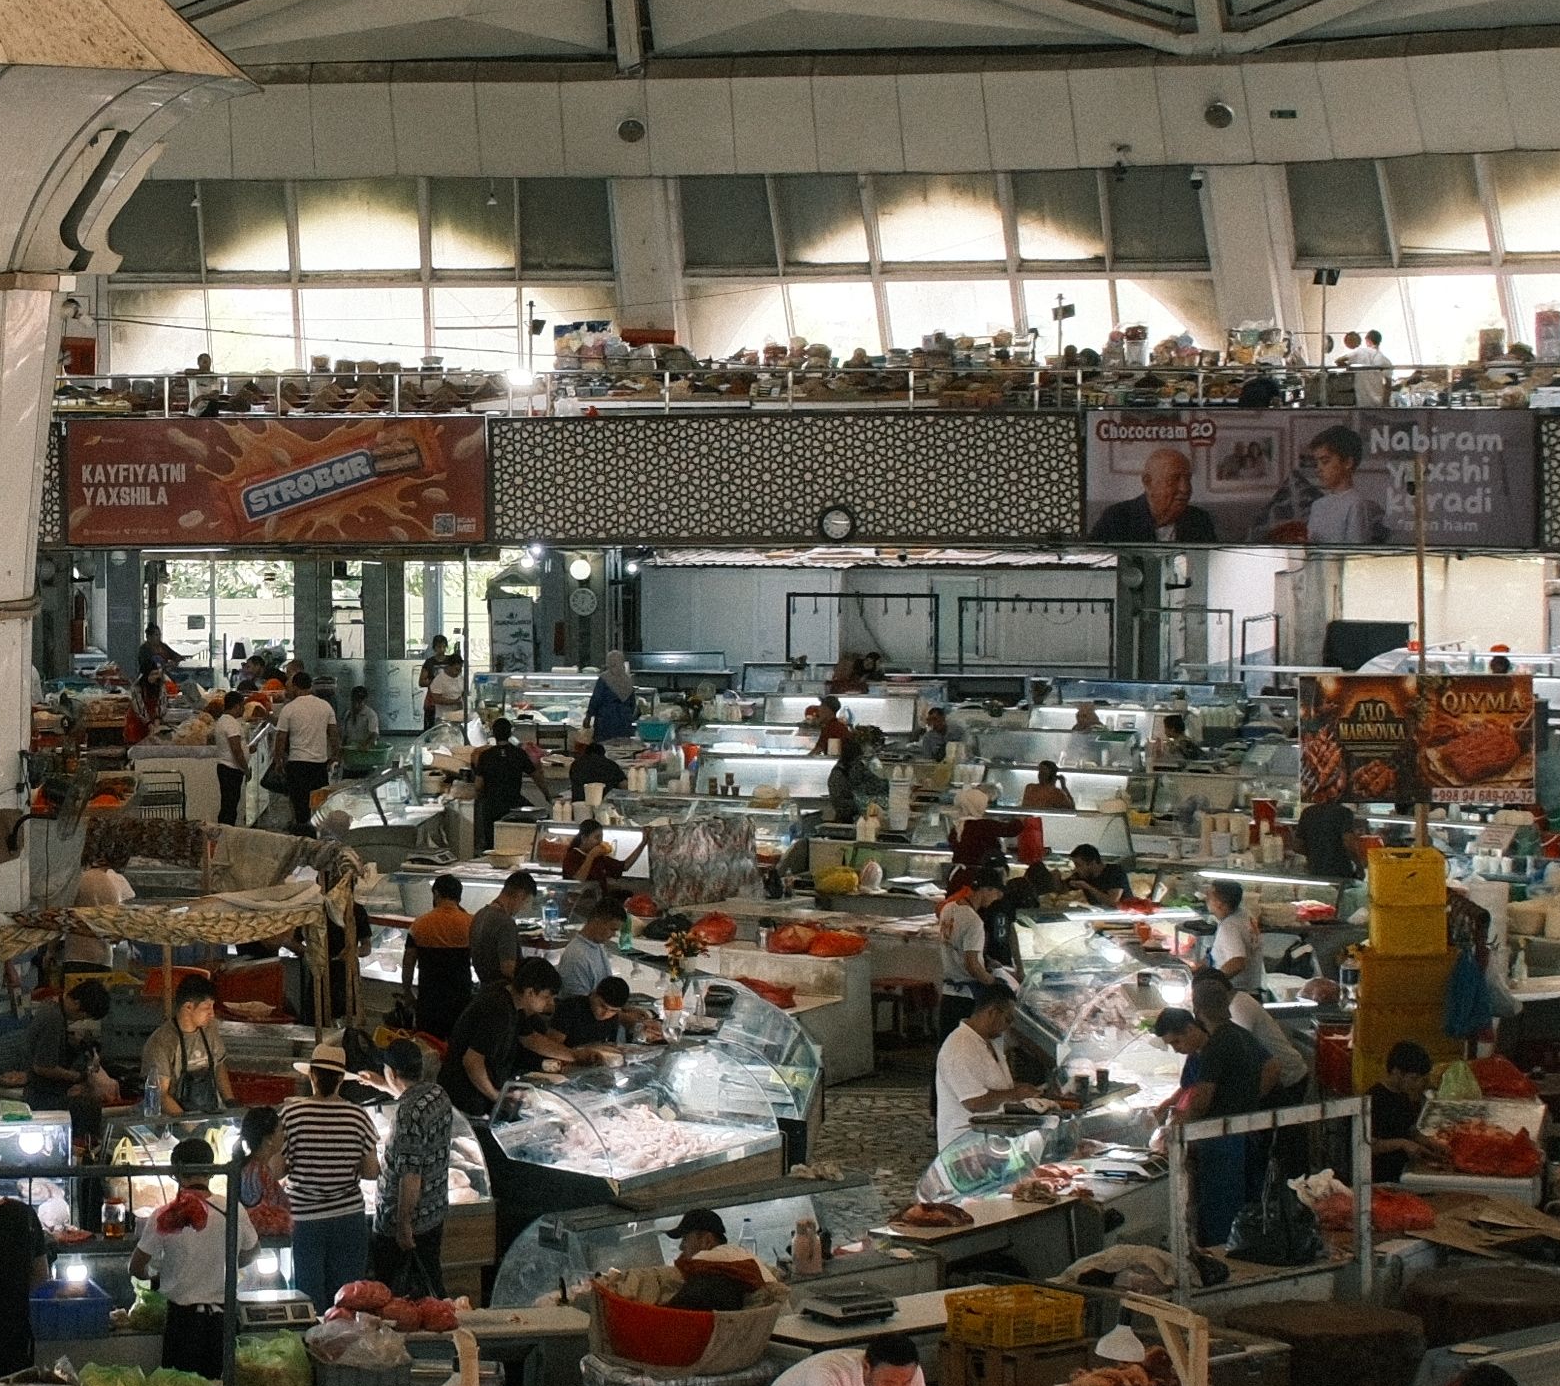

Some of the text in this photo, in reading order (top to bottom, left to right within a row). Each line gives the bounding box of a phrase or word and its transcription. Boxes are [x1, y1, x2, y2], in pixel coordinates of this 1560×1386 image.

[1100, 422, 1213, 439] Chococream 20
[1371, 424, 1503, 454] Nabiram
[81, 463, 187, 484] KAYFIYATNI
[247, 450, 373, 513] STROBAR
[82, 485, 169, 507] YAXSHILA
[1443, 518, 1479, 532] ham
[1441, 690, 1526, 714] QIYMA
[1338, 722, 1406, 741] MARINOVKA
[1433, 788, 1460, 803] +998
[1462, 789, 1477, 803] 94
